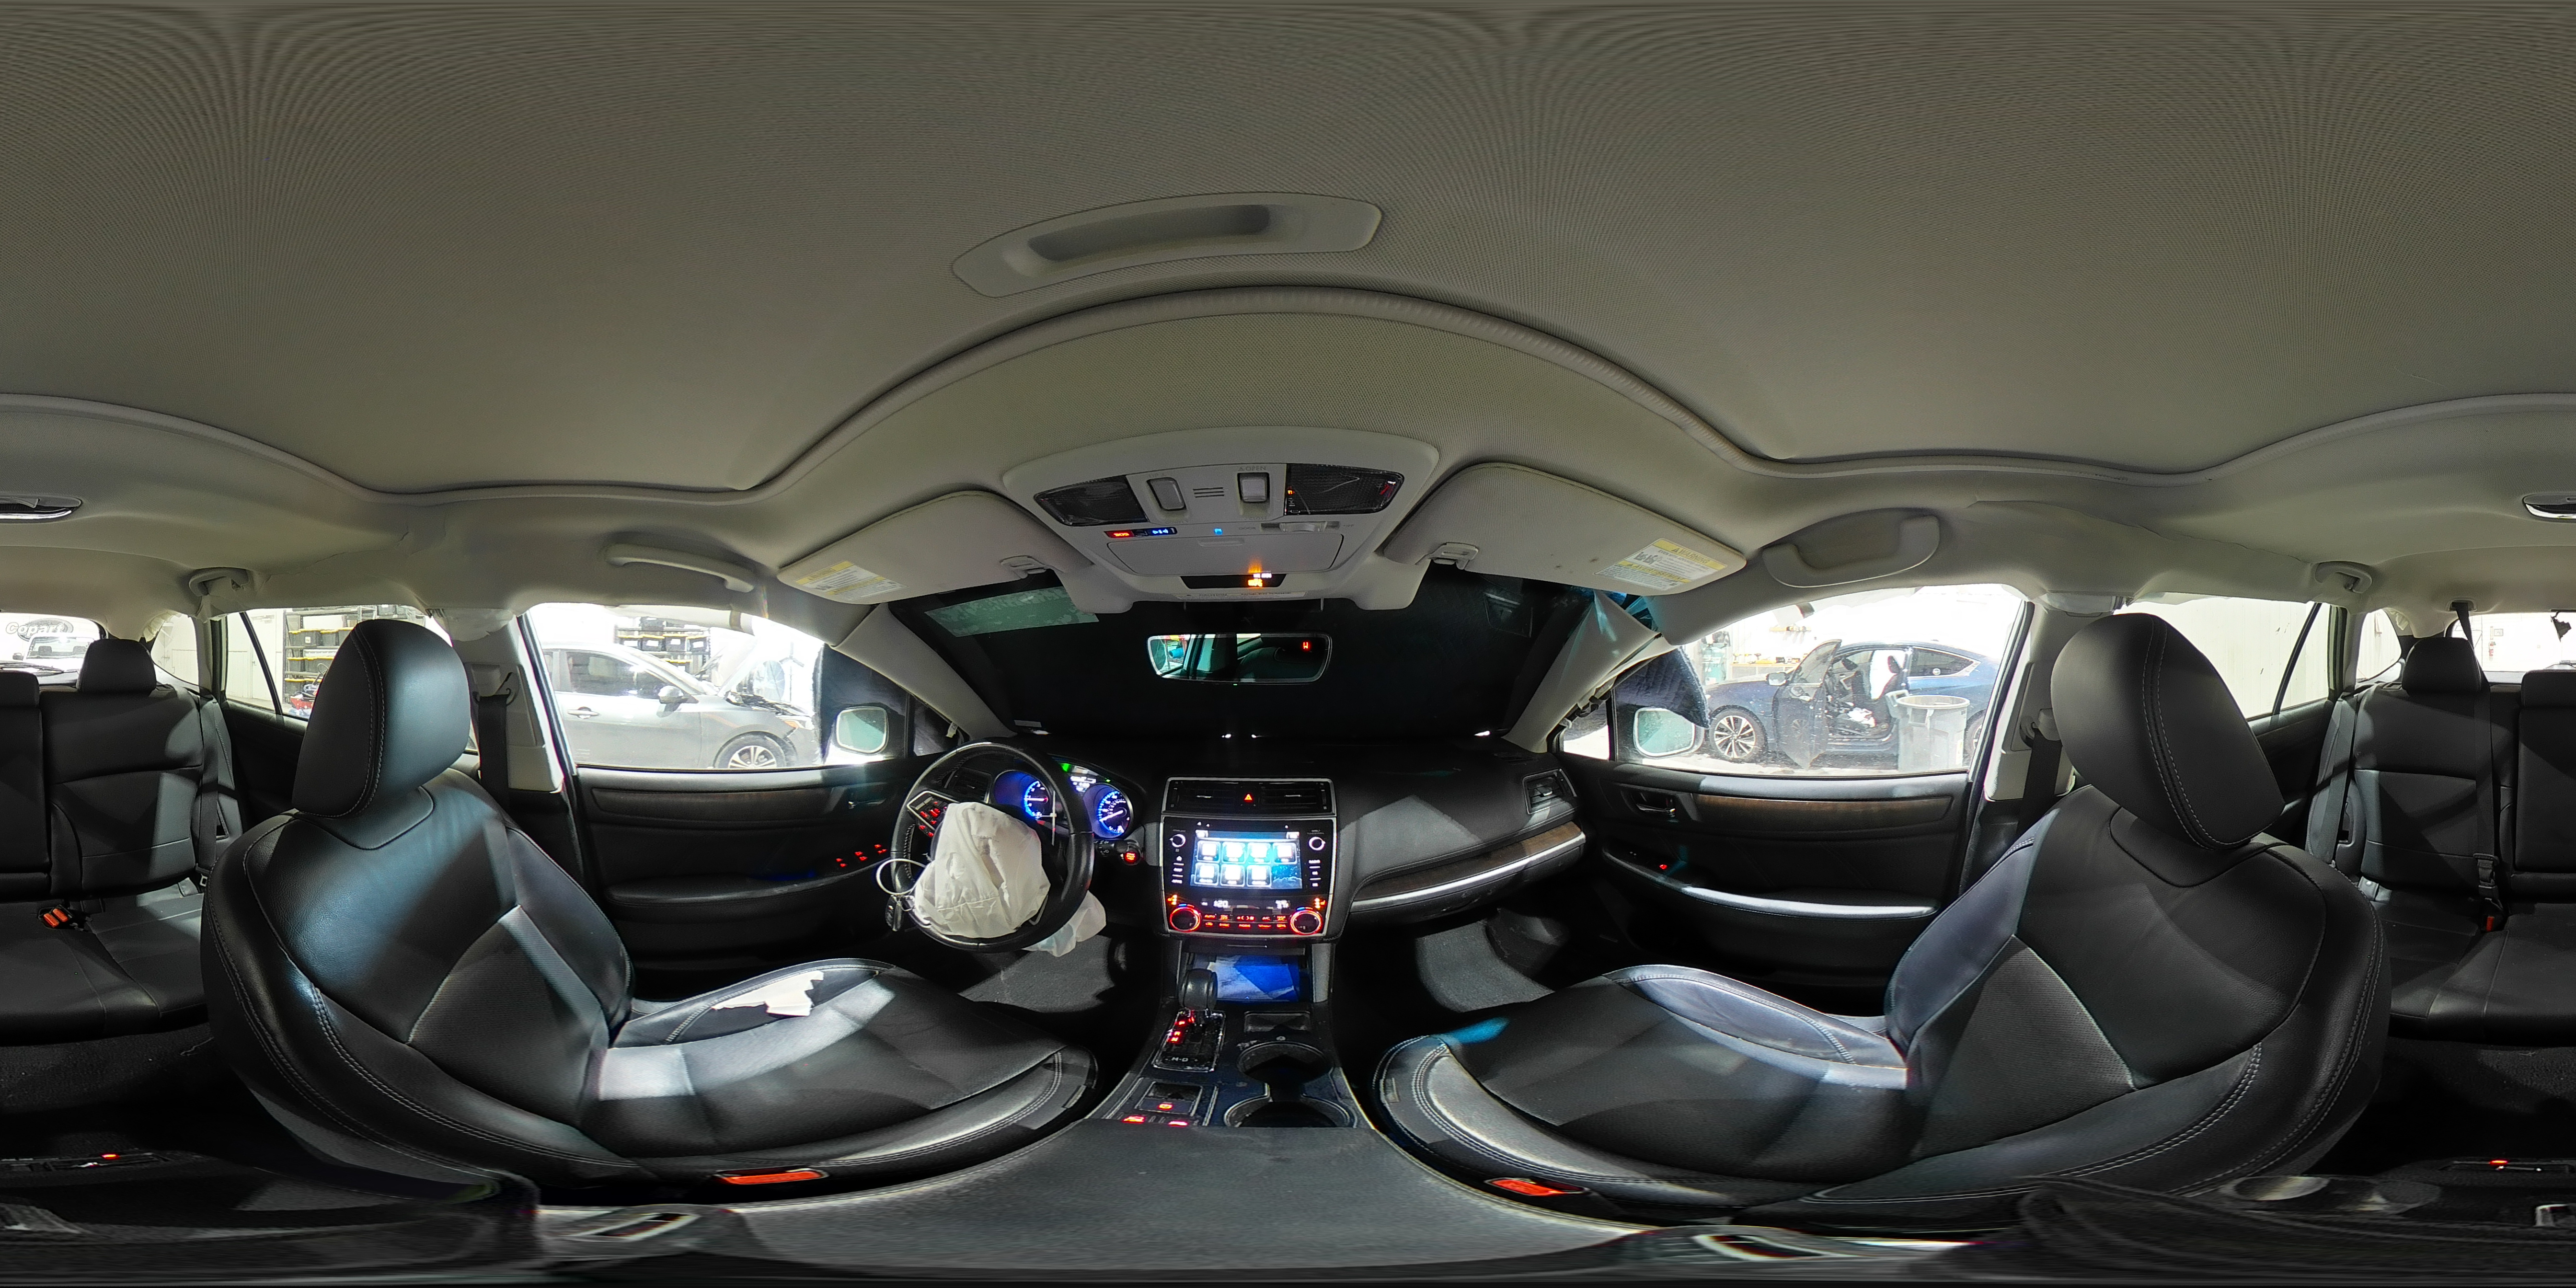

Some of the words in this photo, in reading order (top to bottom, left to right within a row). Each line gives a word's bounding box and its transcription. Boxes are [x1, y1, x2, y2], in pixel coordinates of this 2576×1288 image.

[1678, 549, 1710, 564] WARNING
[1634, 564, 1685, 581] AVERTISSEMENT
[6, 622, 65, 638] Copart
